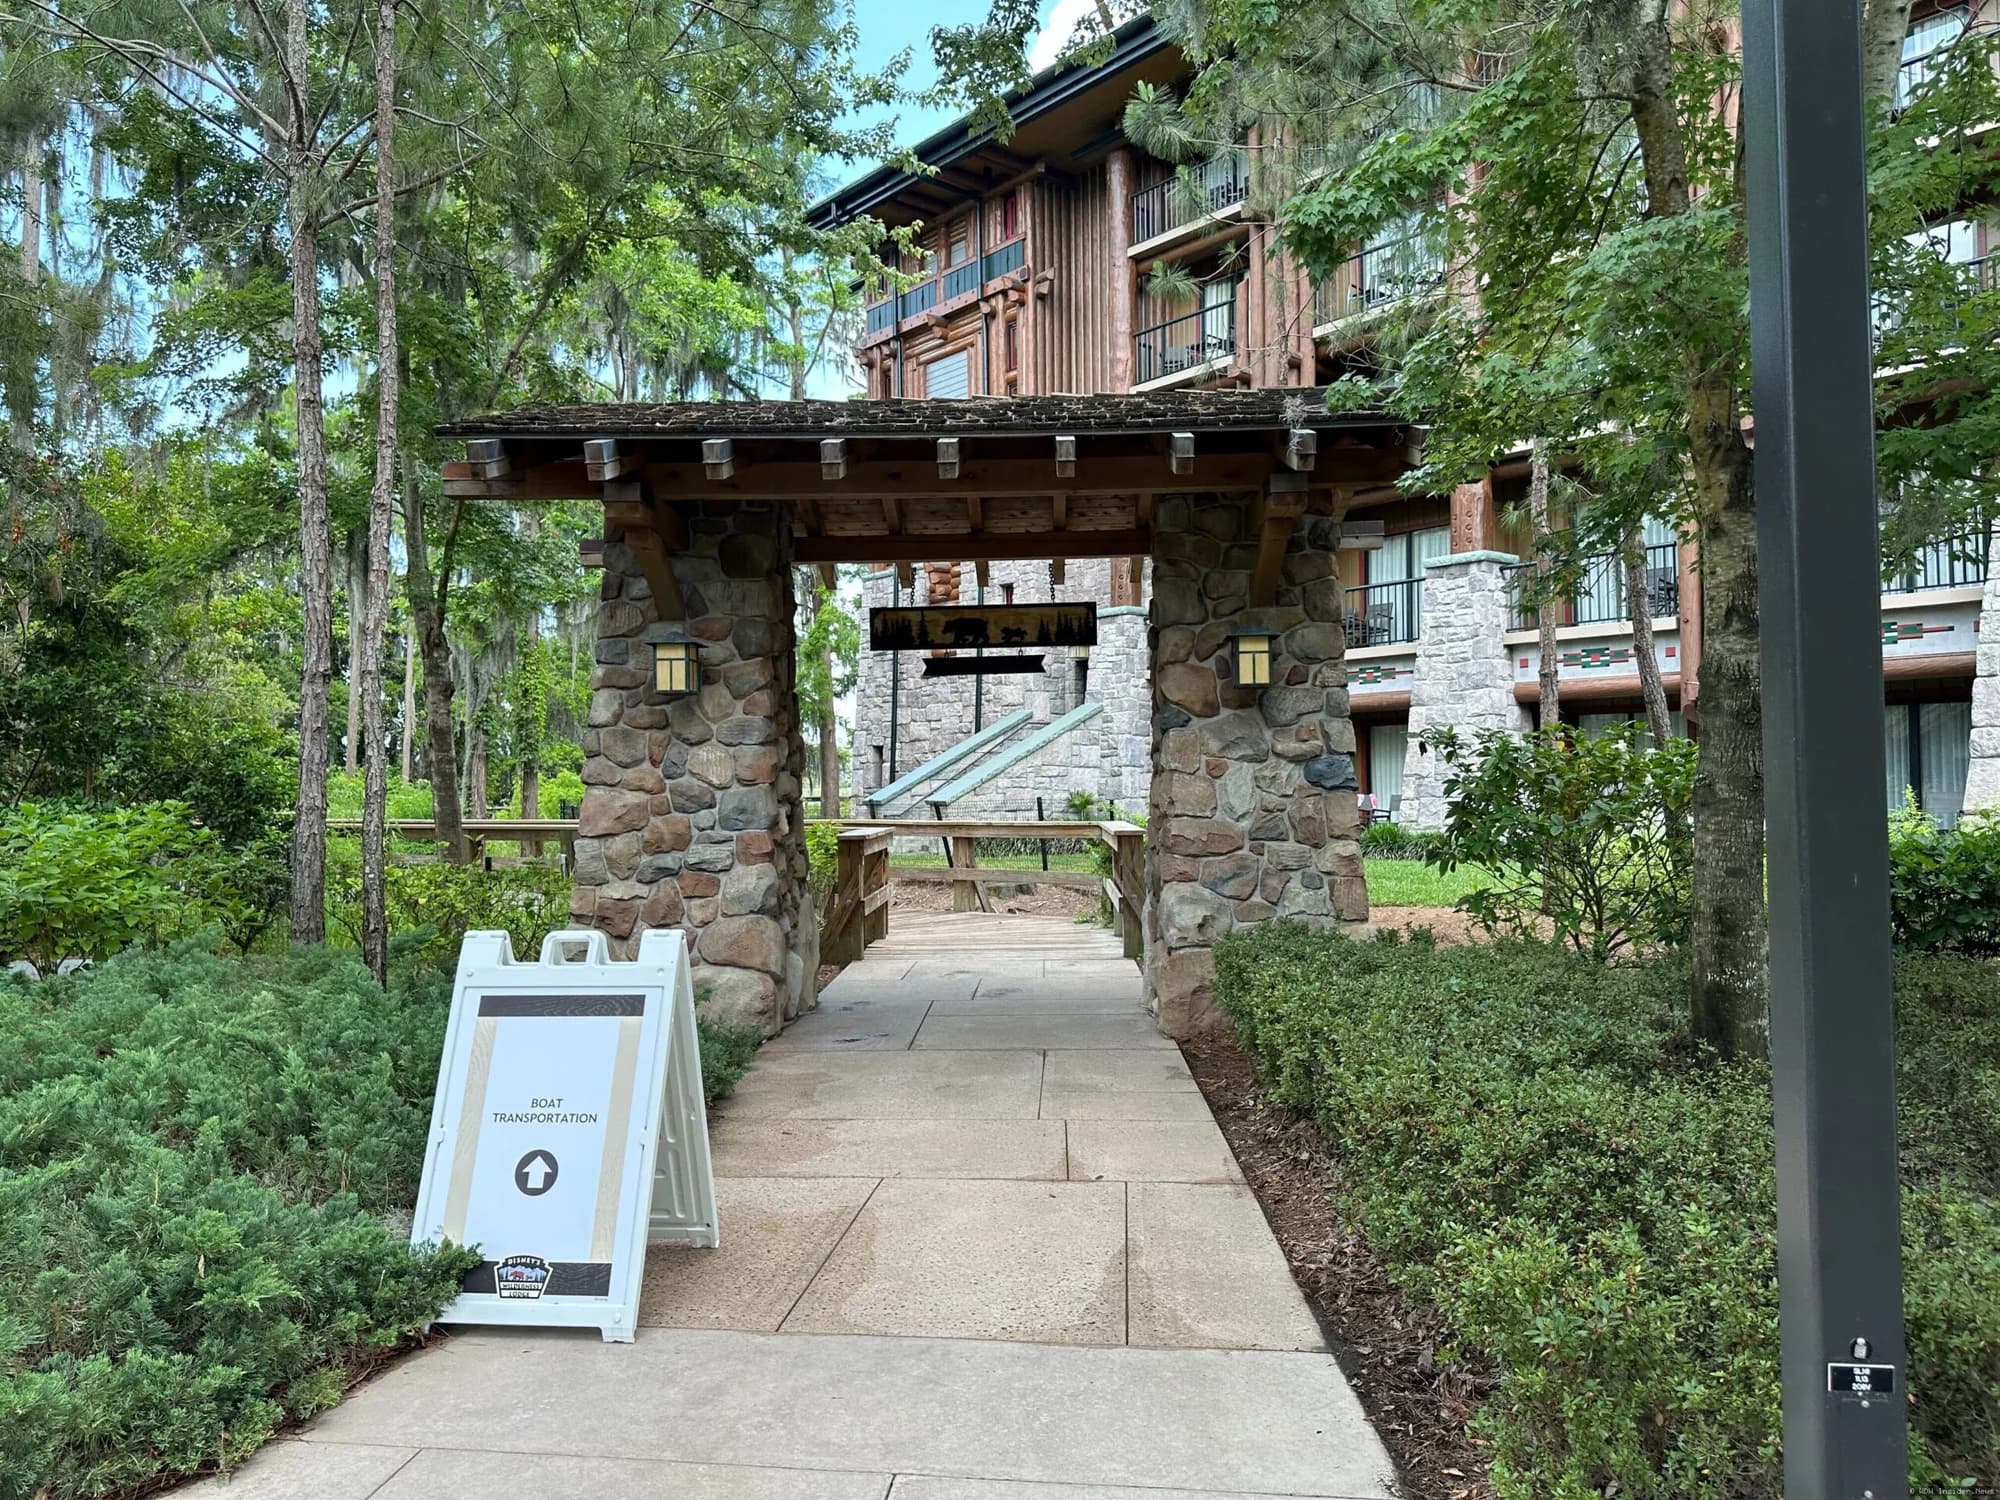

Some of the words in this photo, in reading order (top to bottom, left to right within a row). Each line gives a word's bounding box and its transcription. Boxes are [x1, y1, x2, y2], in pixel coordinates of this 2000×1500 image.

[531, 1098, 564, 1109] BOAT
[492, 1112, 598, 1123] TRANSPORTATION
[507, 1256, 541, 1265] DISNEY'S
